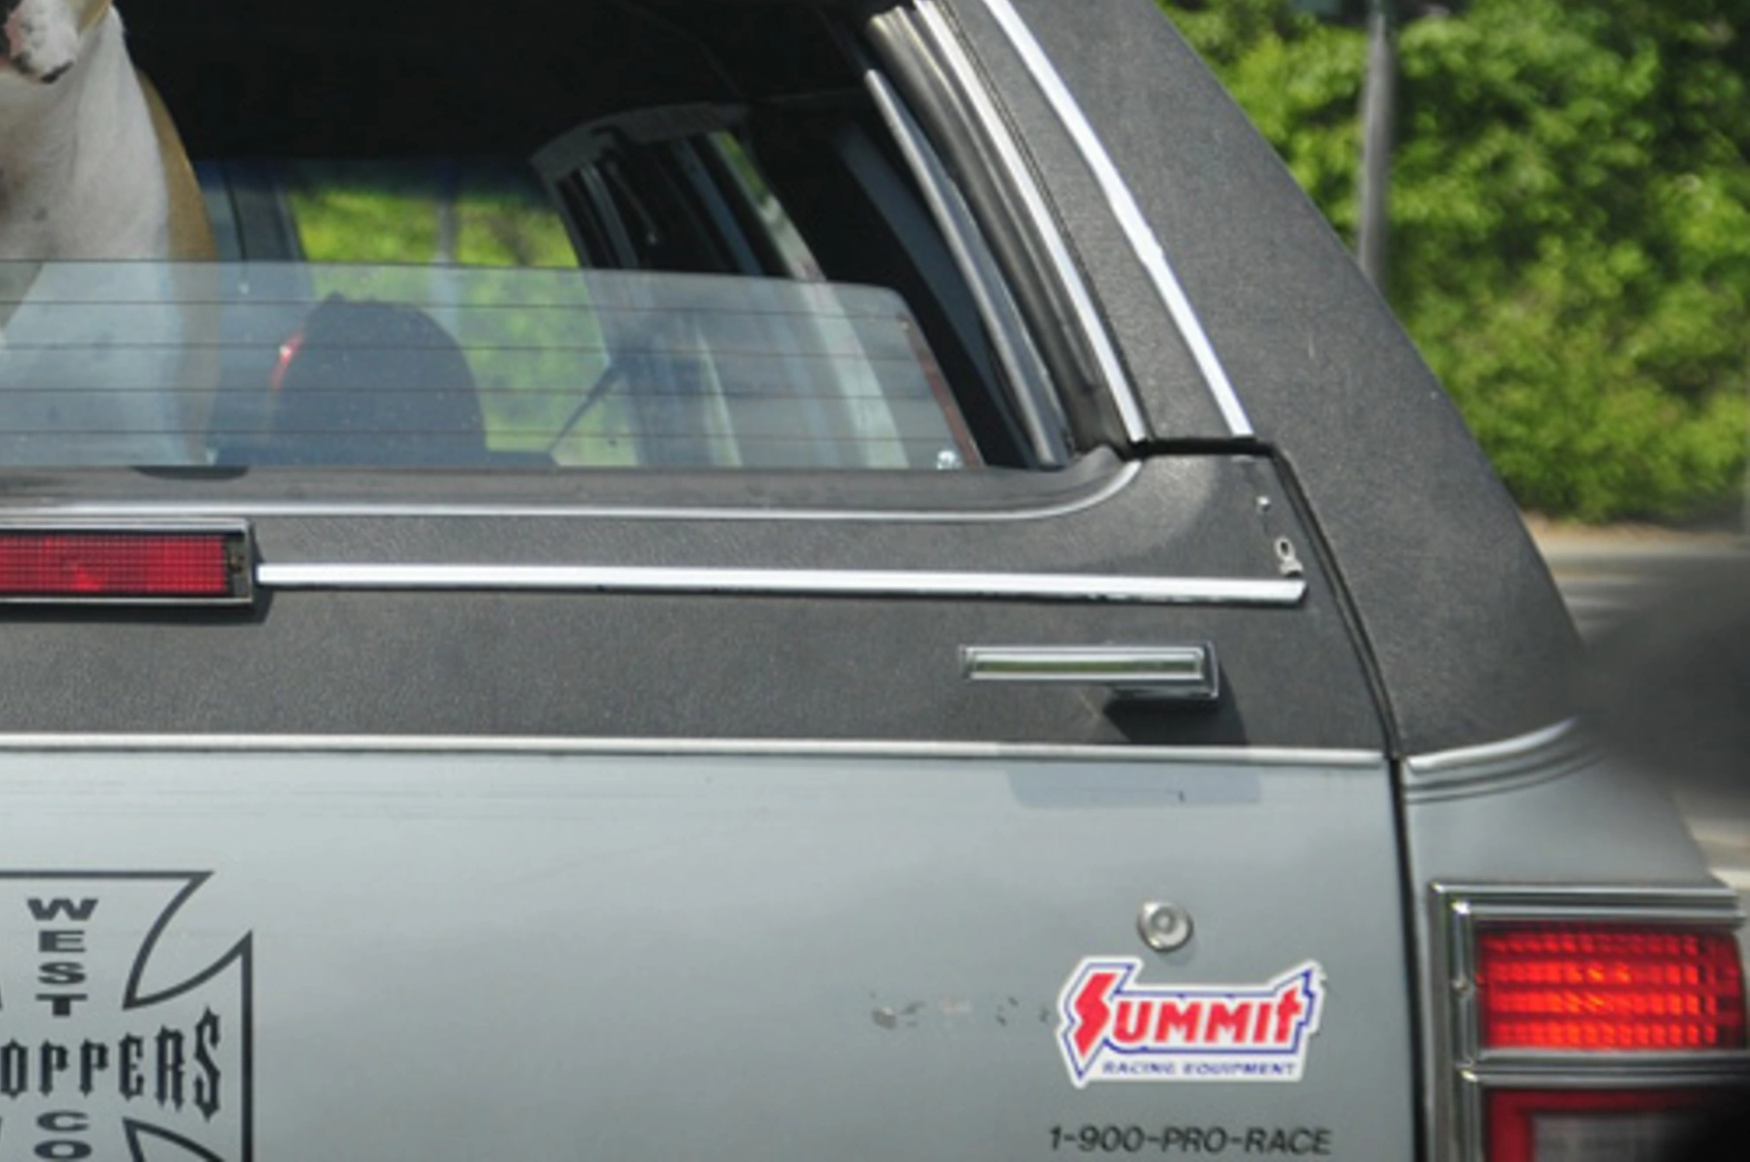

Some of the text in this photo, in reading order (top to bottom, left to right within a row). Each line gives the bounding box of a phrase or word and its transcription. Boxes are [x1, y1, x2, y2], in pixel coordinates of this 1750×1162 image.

[26, 898, 99, 1018] WEST
[1102, 1061, 1296, 1076] RACING EQUIPMENT
[1049, 1124, 1334, 1157] 1-900-PRO-RACE
